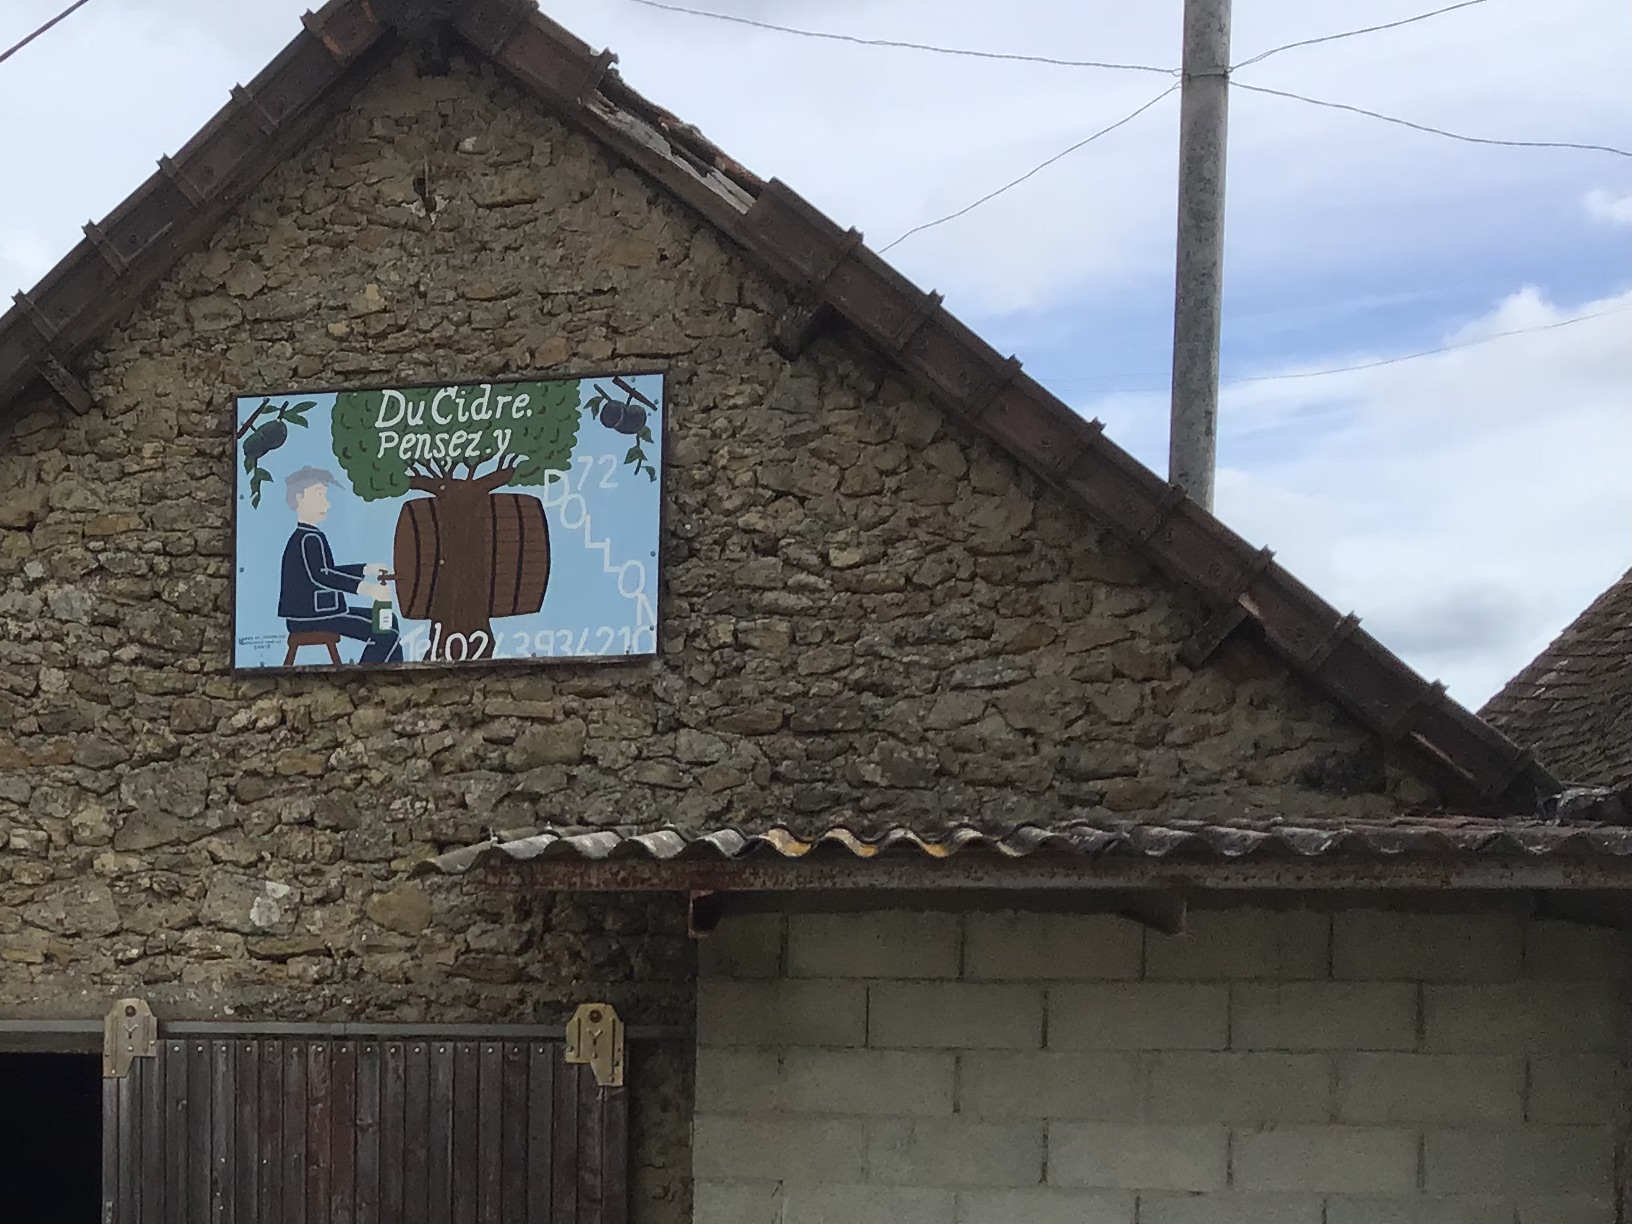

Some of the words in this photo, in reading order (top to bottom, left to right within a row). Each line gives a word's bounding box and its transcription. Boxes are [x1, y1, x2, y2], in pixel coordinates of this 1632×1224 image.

[375, 389, 425, 428] Du
[431, 384, 532, 425] Cidre.
[578, 454, 619, 490] 72
[543, 468, 656, 626] DOLLON
